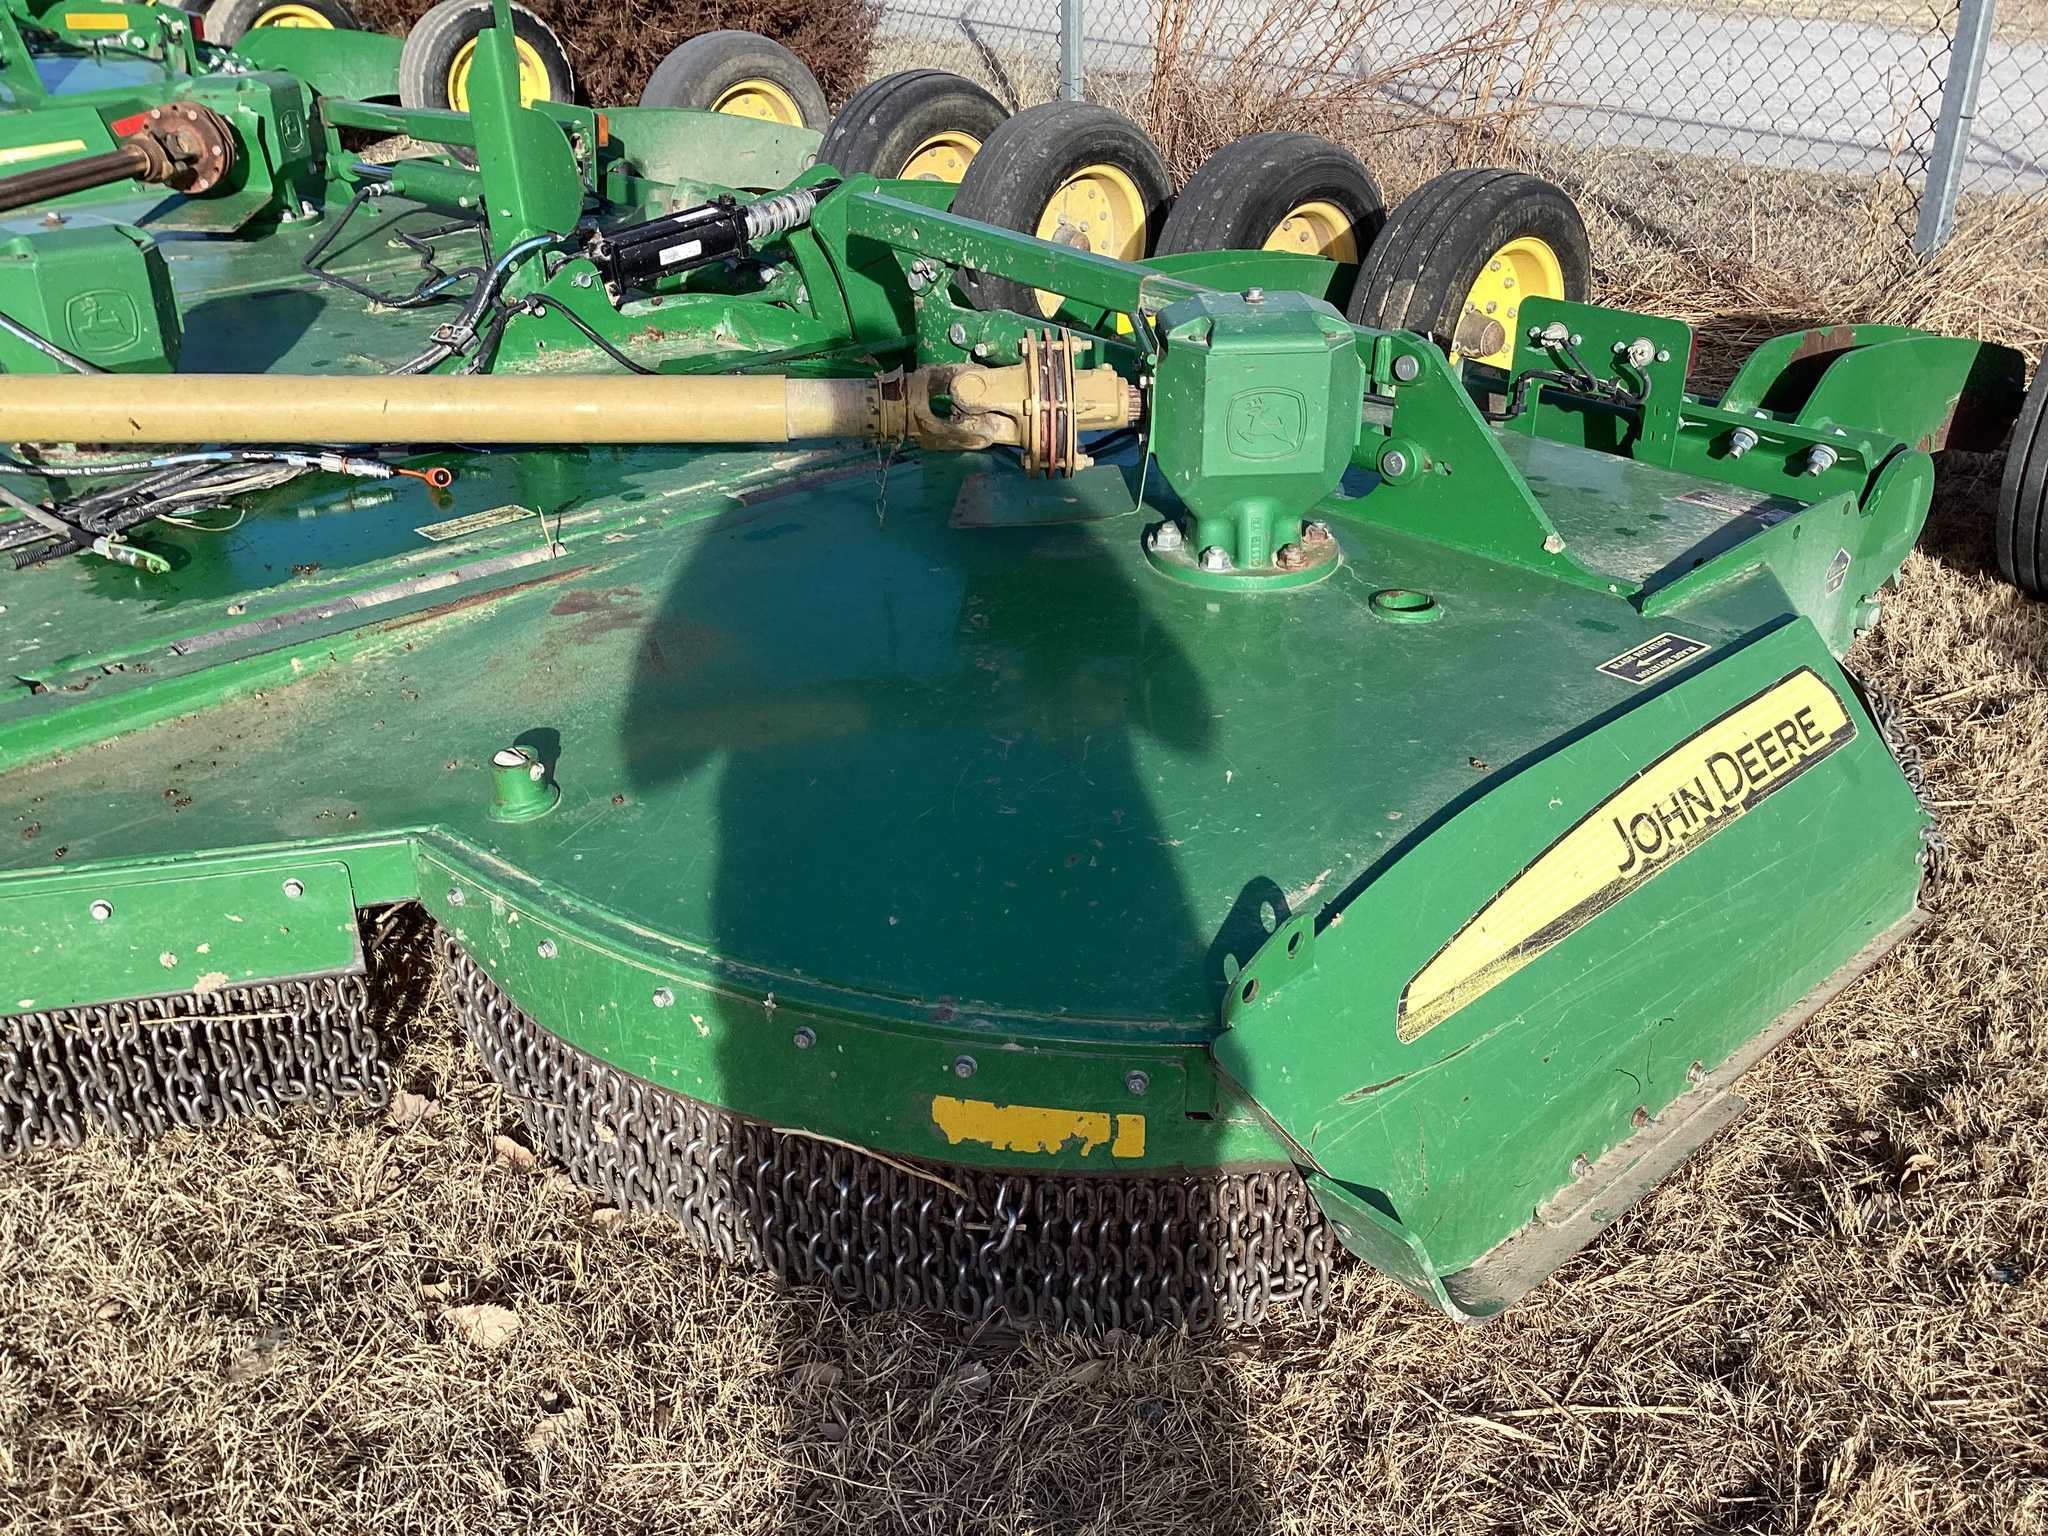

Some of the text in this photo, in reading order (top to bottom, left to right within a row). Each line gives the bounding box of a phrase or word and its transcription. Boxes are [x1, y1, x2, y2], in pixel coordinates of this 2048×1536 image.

[1608, 637, 1672, 670] BLADE ROTATION
[1634, 645, 1699, 679] BLADE ROTATION
[1612, 705, 1825, 874] JOHN DEERE
